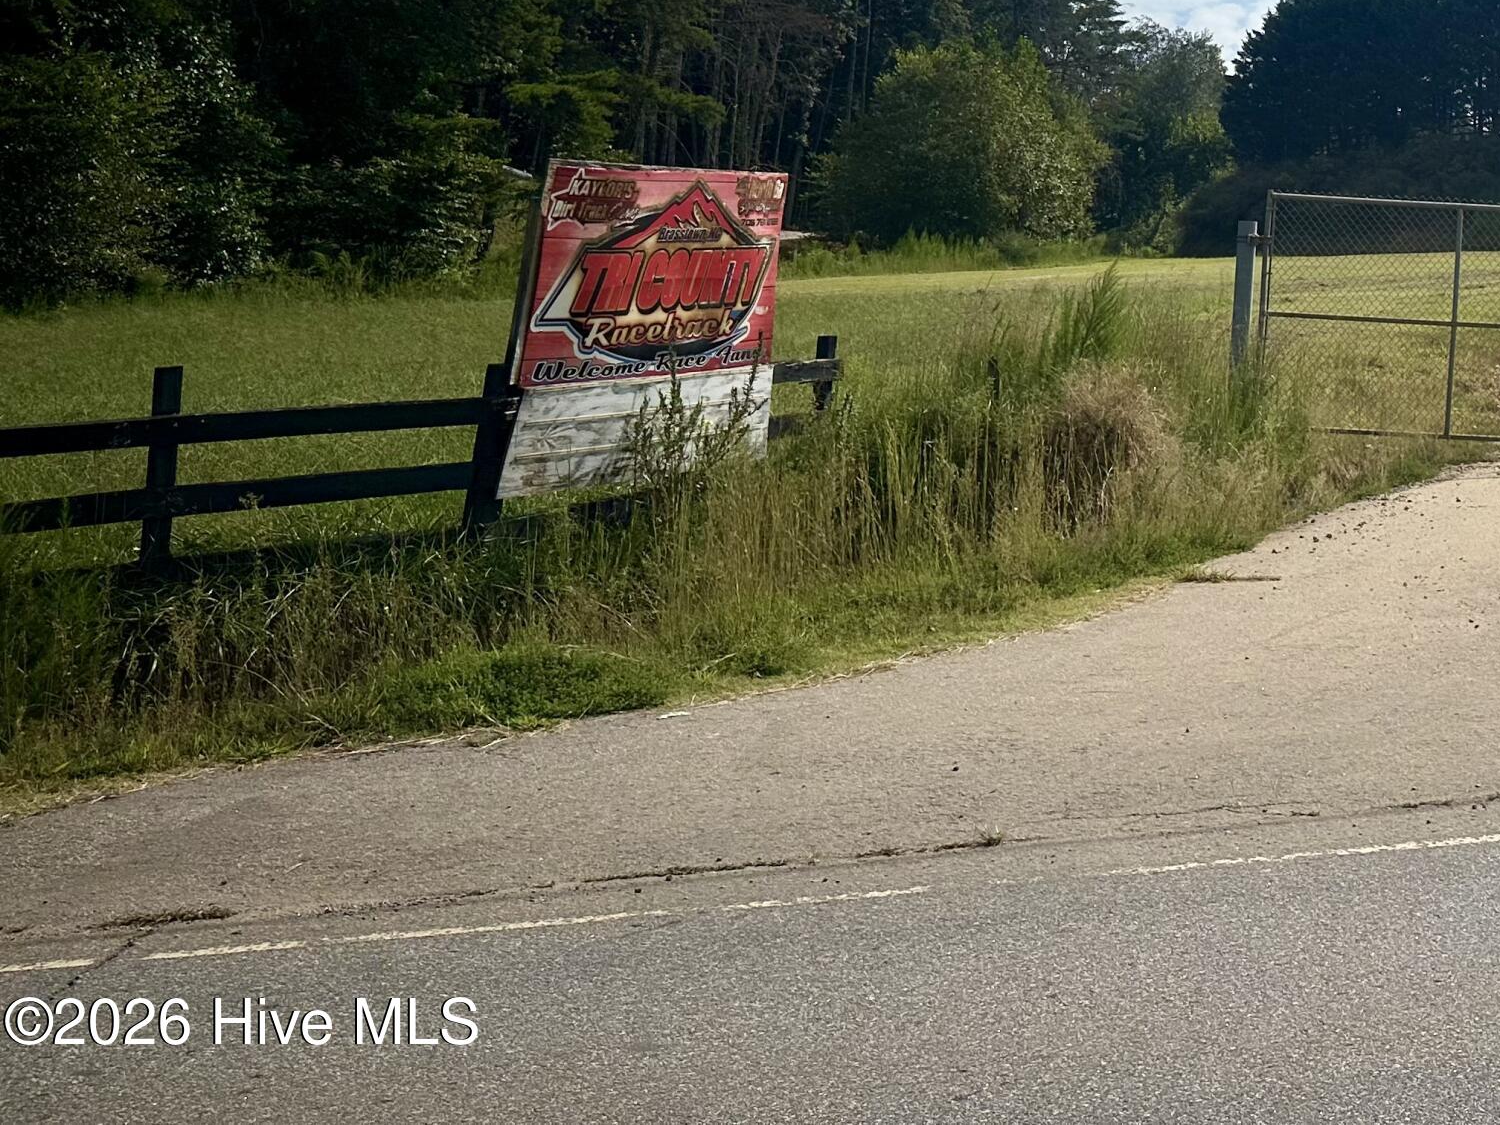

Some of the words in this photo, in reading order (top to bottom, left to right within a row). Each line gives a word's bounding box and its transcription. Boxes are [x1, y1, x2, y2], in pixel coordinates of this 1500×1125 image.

[552, 200, 577, 218] Dirt
[570, 251, 645, 316] TRI
[584, 309, 735, 348] Racetrack
[531, 360, 646, 382] Welcome
